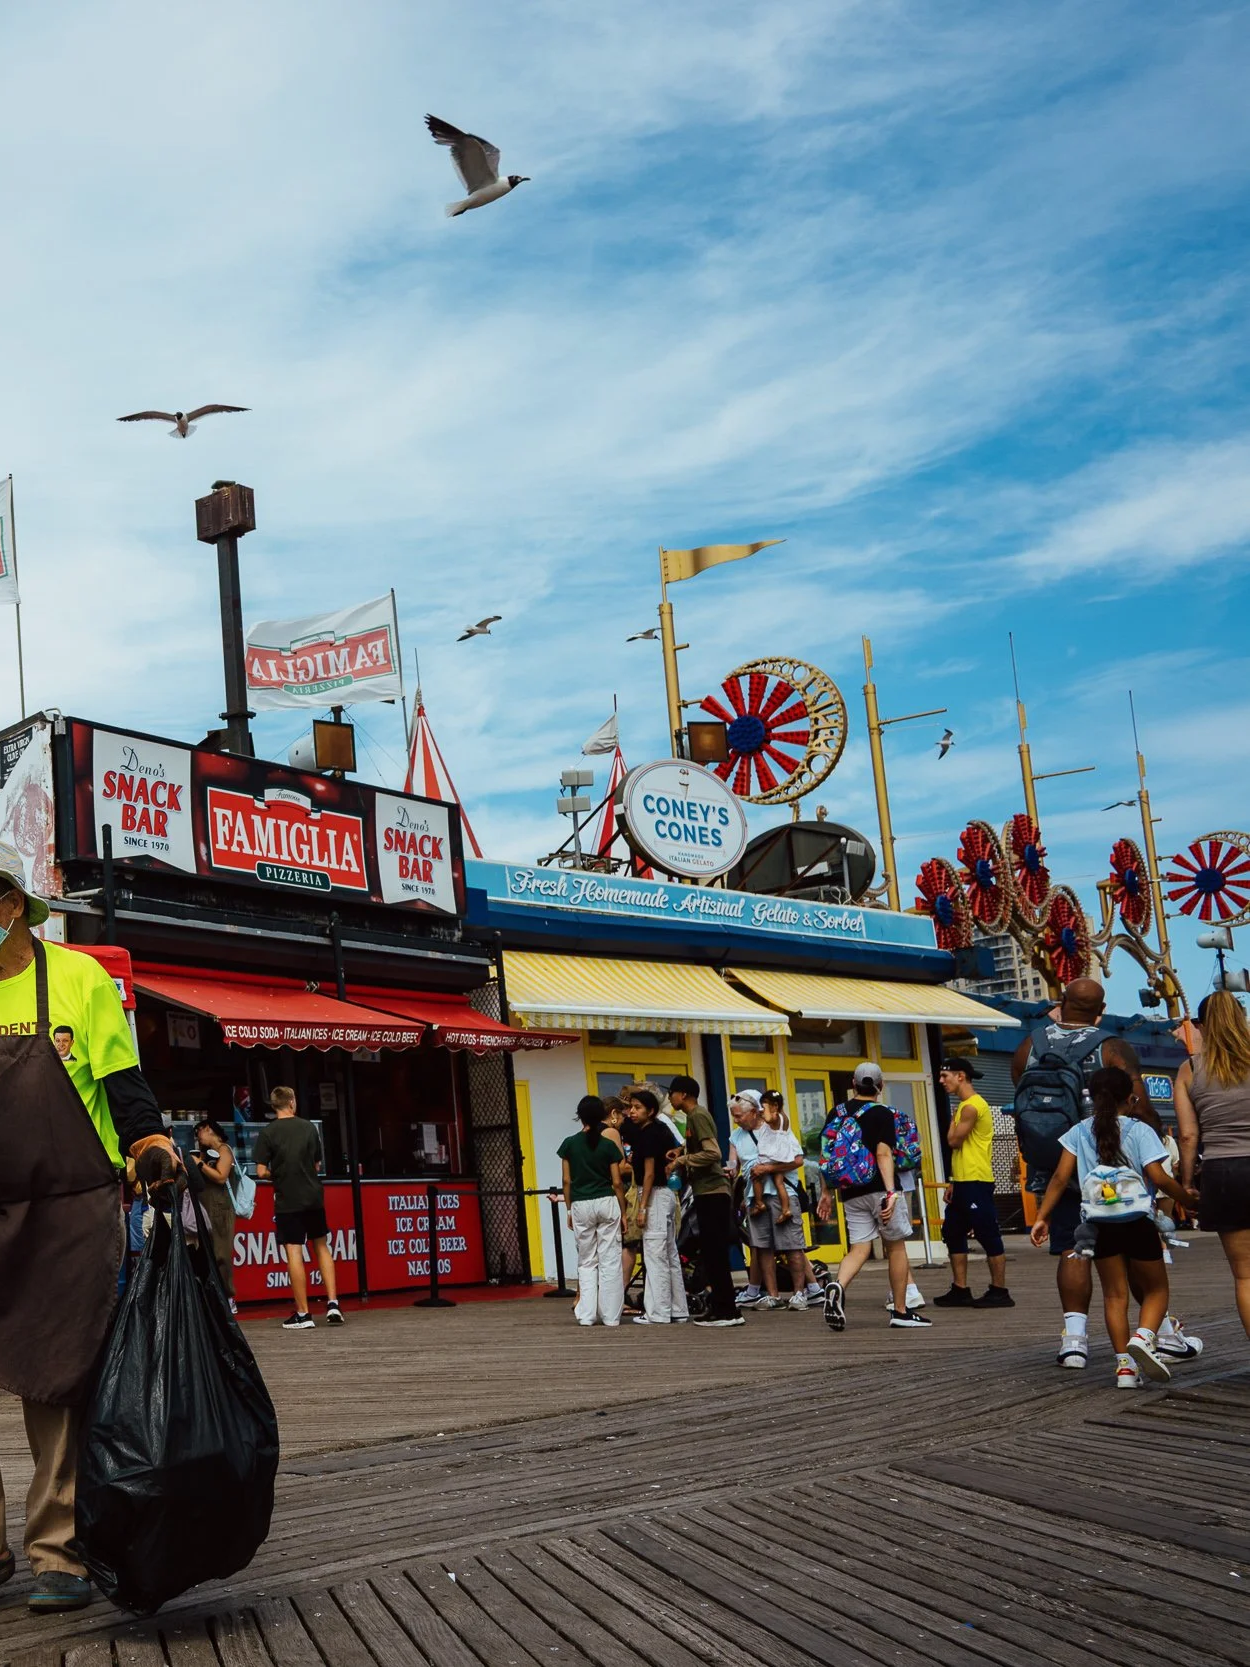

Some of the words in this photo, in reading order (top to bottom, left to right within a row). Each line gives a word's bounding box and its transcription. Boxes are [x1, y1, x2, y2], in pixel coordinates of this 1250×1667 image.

[120, 746, 165, 778] Deno's
[102, 770, 183, 812] SNACK
[396, 805, 430, 833] Deno's
[643, 794, 730, 826] CONEY'S
[121, 803, 168, 838] BAR
[213, 807, 360, 873] FAMIGLIA
[654, 819, 723, 848] CONES
[124, 836, 148, 848] SINCE
[151, 841, 170, 852] 1970
[384, 827, 444, 861] SNACK
[398, 855, 434, 884] BAR
[669, 855, 691, 864] ITALIAN
[266, 866, 322, 886] PIZZERIA
[401, 883, 419, 893] SINCE
[421, 886, 436, 896] 1970
[510, 869, 568, 898] Fresh
[569, 875, 670, 911] Homemade
[751, 902, 800, 926] Gelato
[802, 912, 812, 926] &
[813, 909, 863, 933] Sorbet
[224, 1025, 237, 1038] ICE
[238, 1026, 257, 1038] COLD
[259, 1026, 280, 1039] SODA
[283, 1027, 311, 1040] ITALIAN
[312, 1028, 328, 1040] ICES
[331, 1028, 344, 1040] ICE
[345, 1029, 368, 1041] CREAM
[370, 1030, 381, 1042] ICE
[381, 1030, 401, 1043] COLD
[445, 1032, 459, 1043] HOT
[459, 1033, 478, 1045] DOGS
[480, 1034, 502, 1047] FRENCH
[502, 1036, 517, 1047] FRIES
[437, 1194, 460, 1209] ICES
[396, 1217, 414, 1232] ICE
[416, 1215, 456, 1231] CRAM
[387, 1239, 406, 1255] ICE
[408, 1238, 430, 1254] COL
[438, 1236, 468, 1252] BEER
[407, 1258, 452, 1276] NACOS
[266, 1271, 291, 1288] SIN
